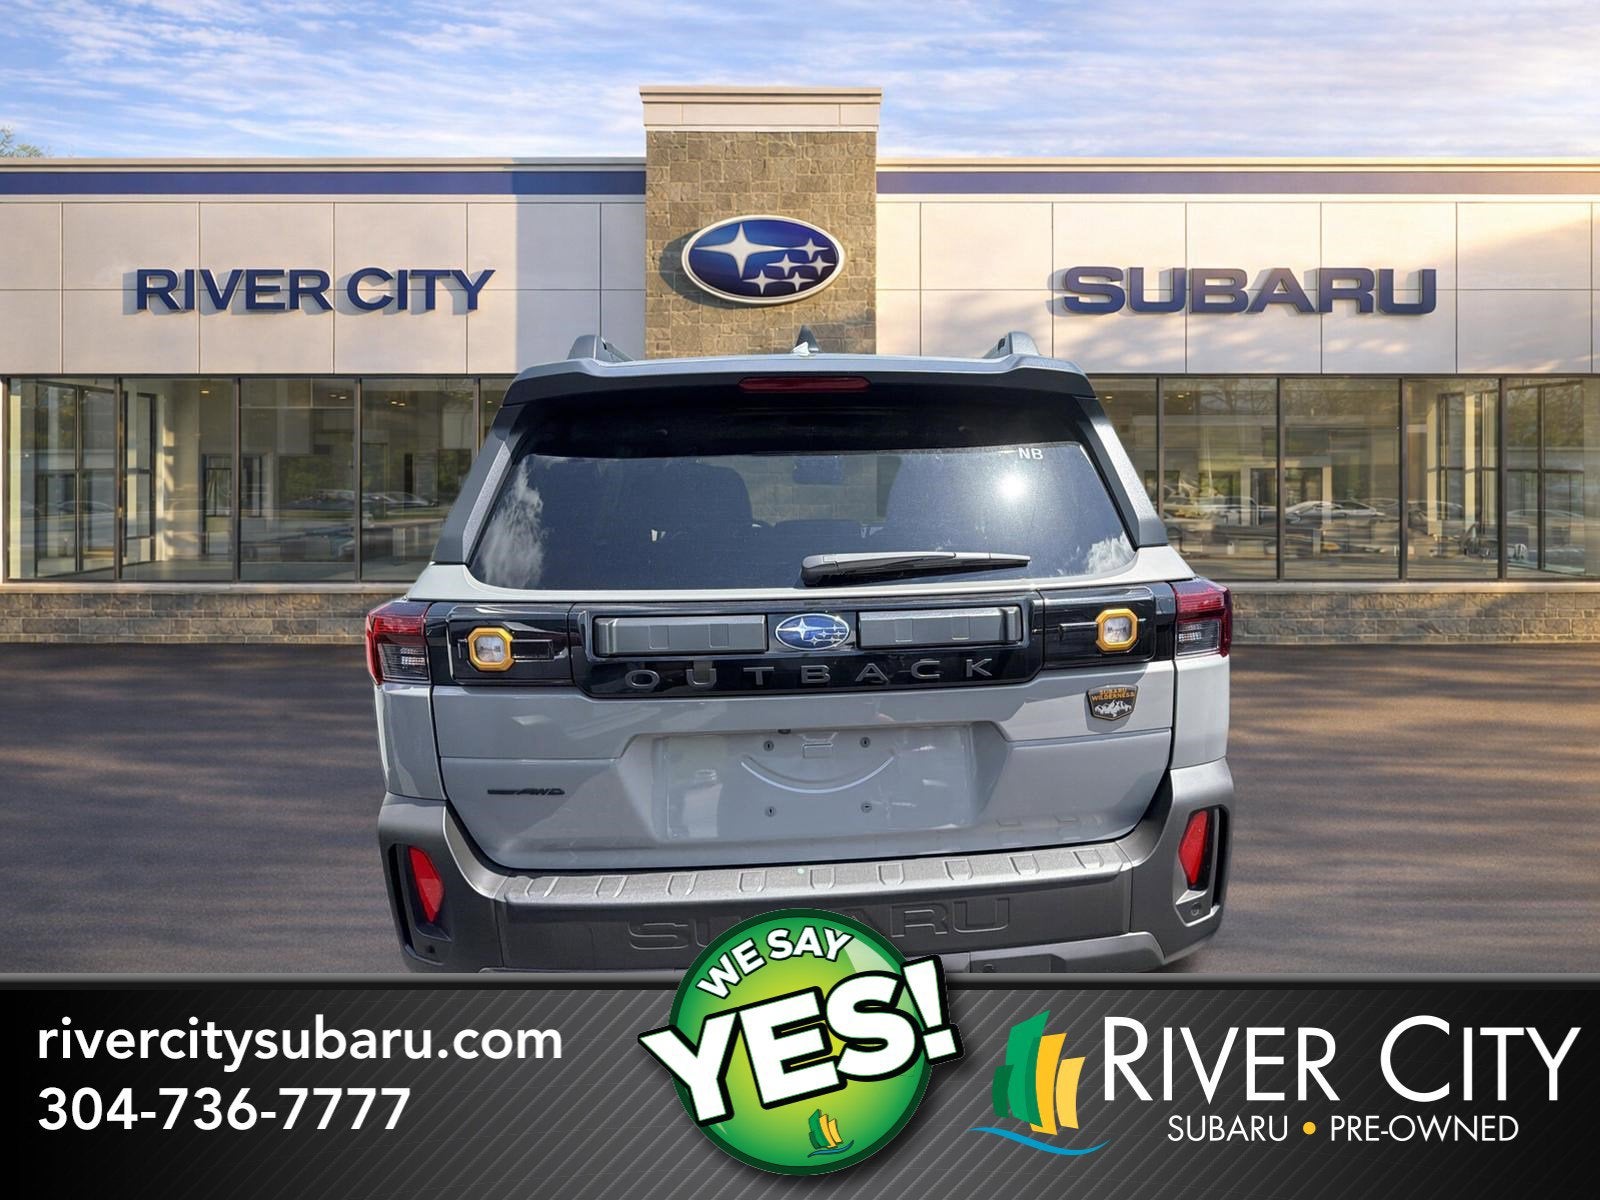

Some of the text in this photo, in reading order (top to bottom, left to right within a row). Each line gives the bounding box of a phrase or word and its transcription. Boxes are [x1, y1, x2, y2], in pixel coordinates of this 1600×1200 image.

[136, 267, 496, 311] RIVER CITY
[1062, 266, 1437, 315] SUBARU
[1018, 447, 1044, 460] NB
[624, 658, 993, 692] OUTBACK
